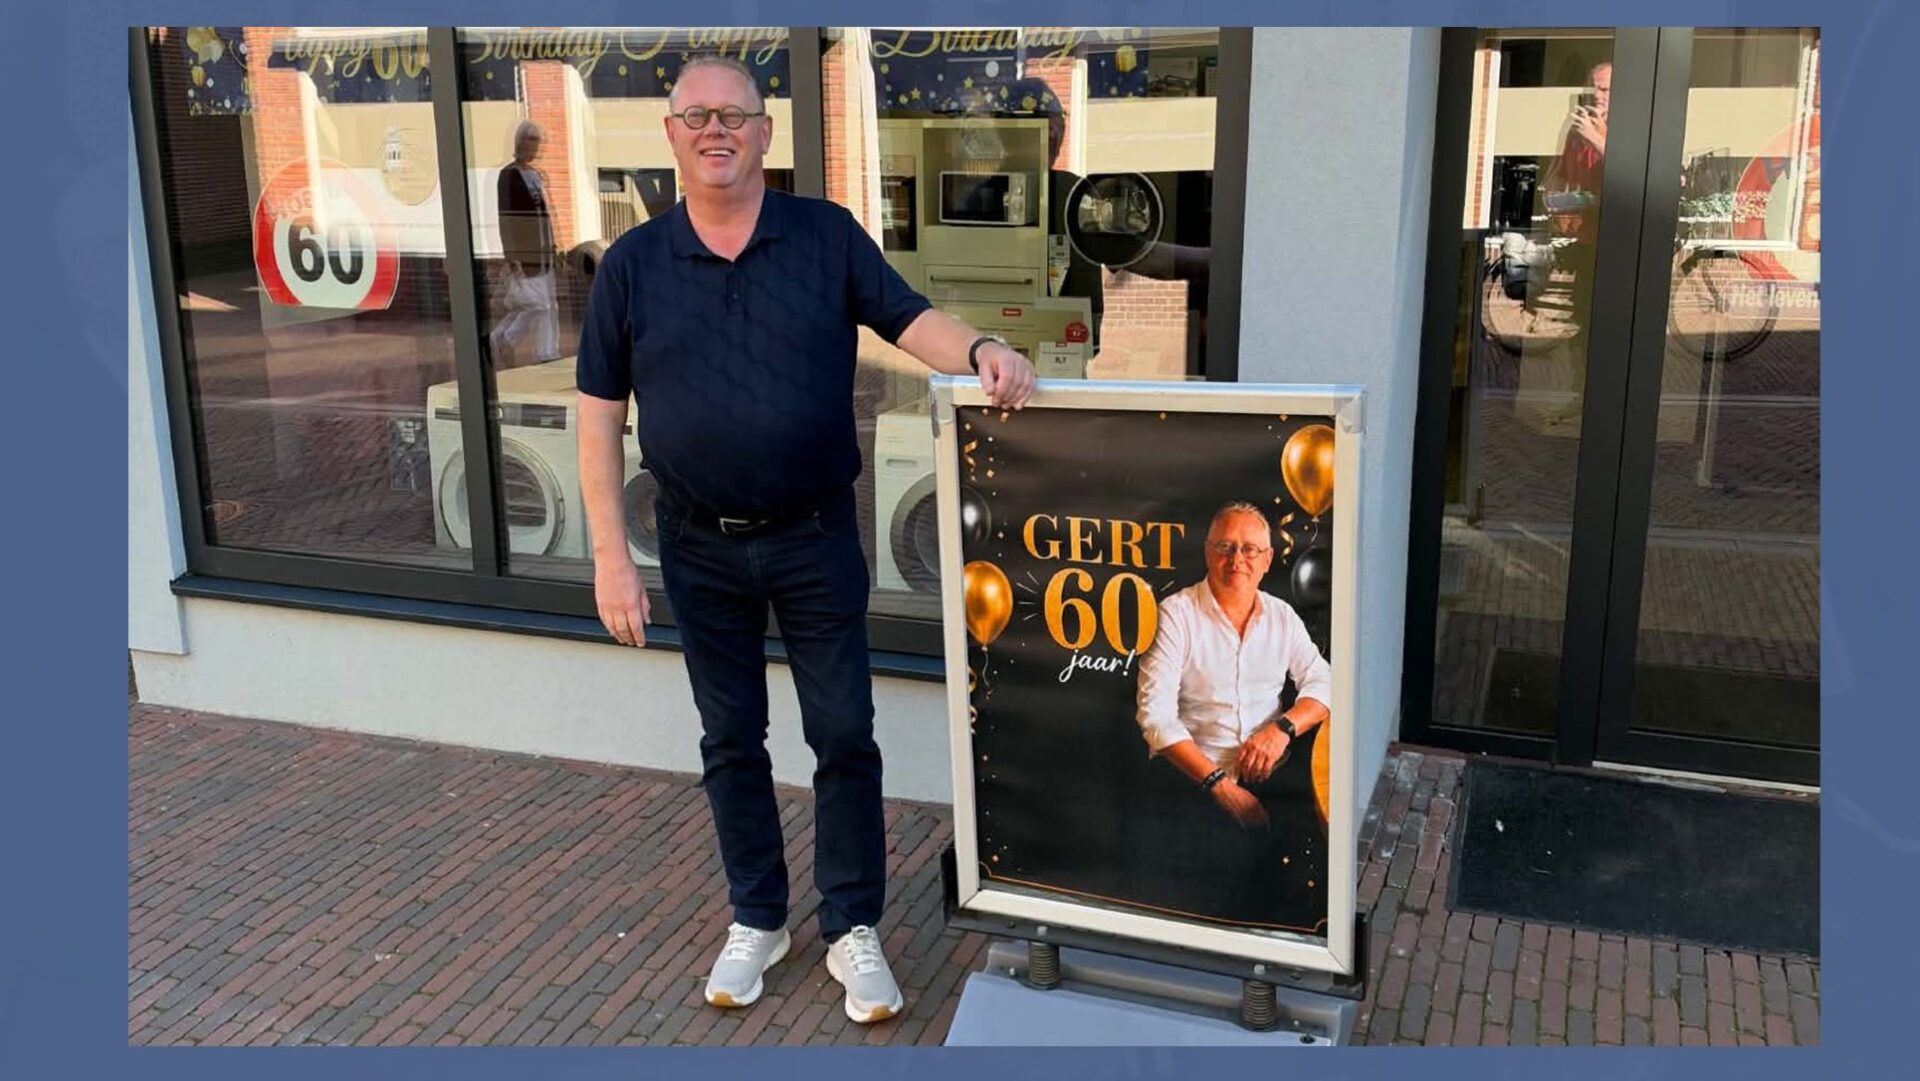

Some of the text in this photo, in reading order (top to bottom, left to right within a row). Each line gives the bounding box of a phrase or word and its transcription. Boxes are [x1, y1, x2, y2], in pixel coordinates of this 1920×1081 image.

[288, 217, 364, 285] 60
[1769, 283, 1819, 308] leven
[1023, 513, 1185, 570] GERT
[1044, 567, 1158, 656] 60
[1058, 649, 1136, 683] jaar!
